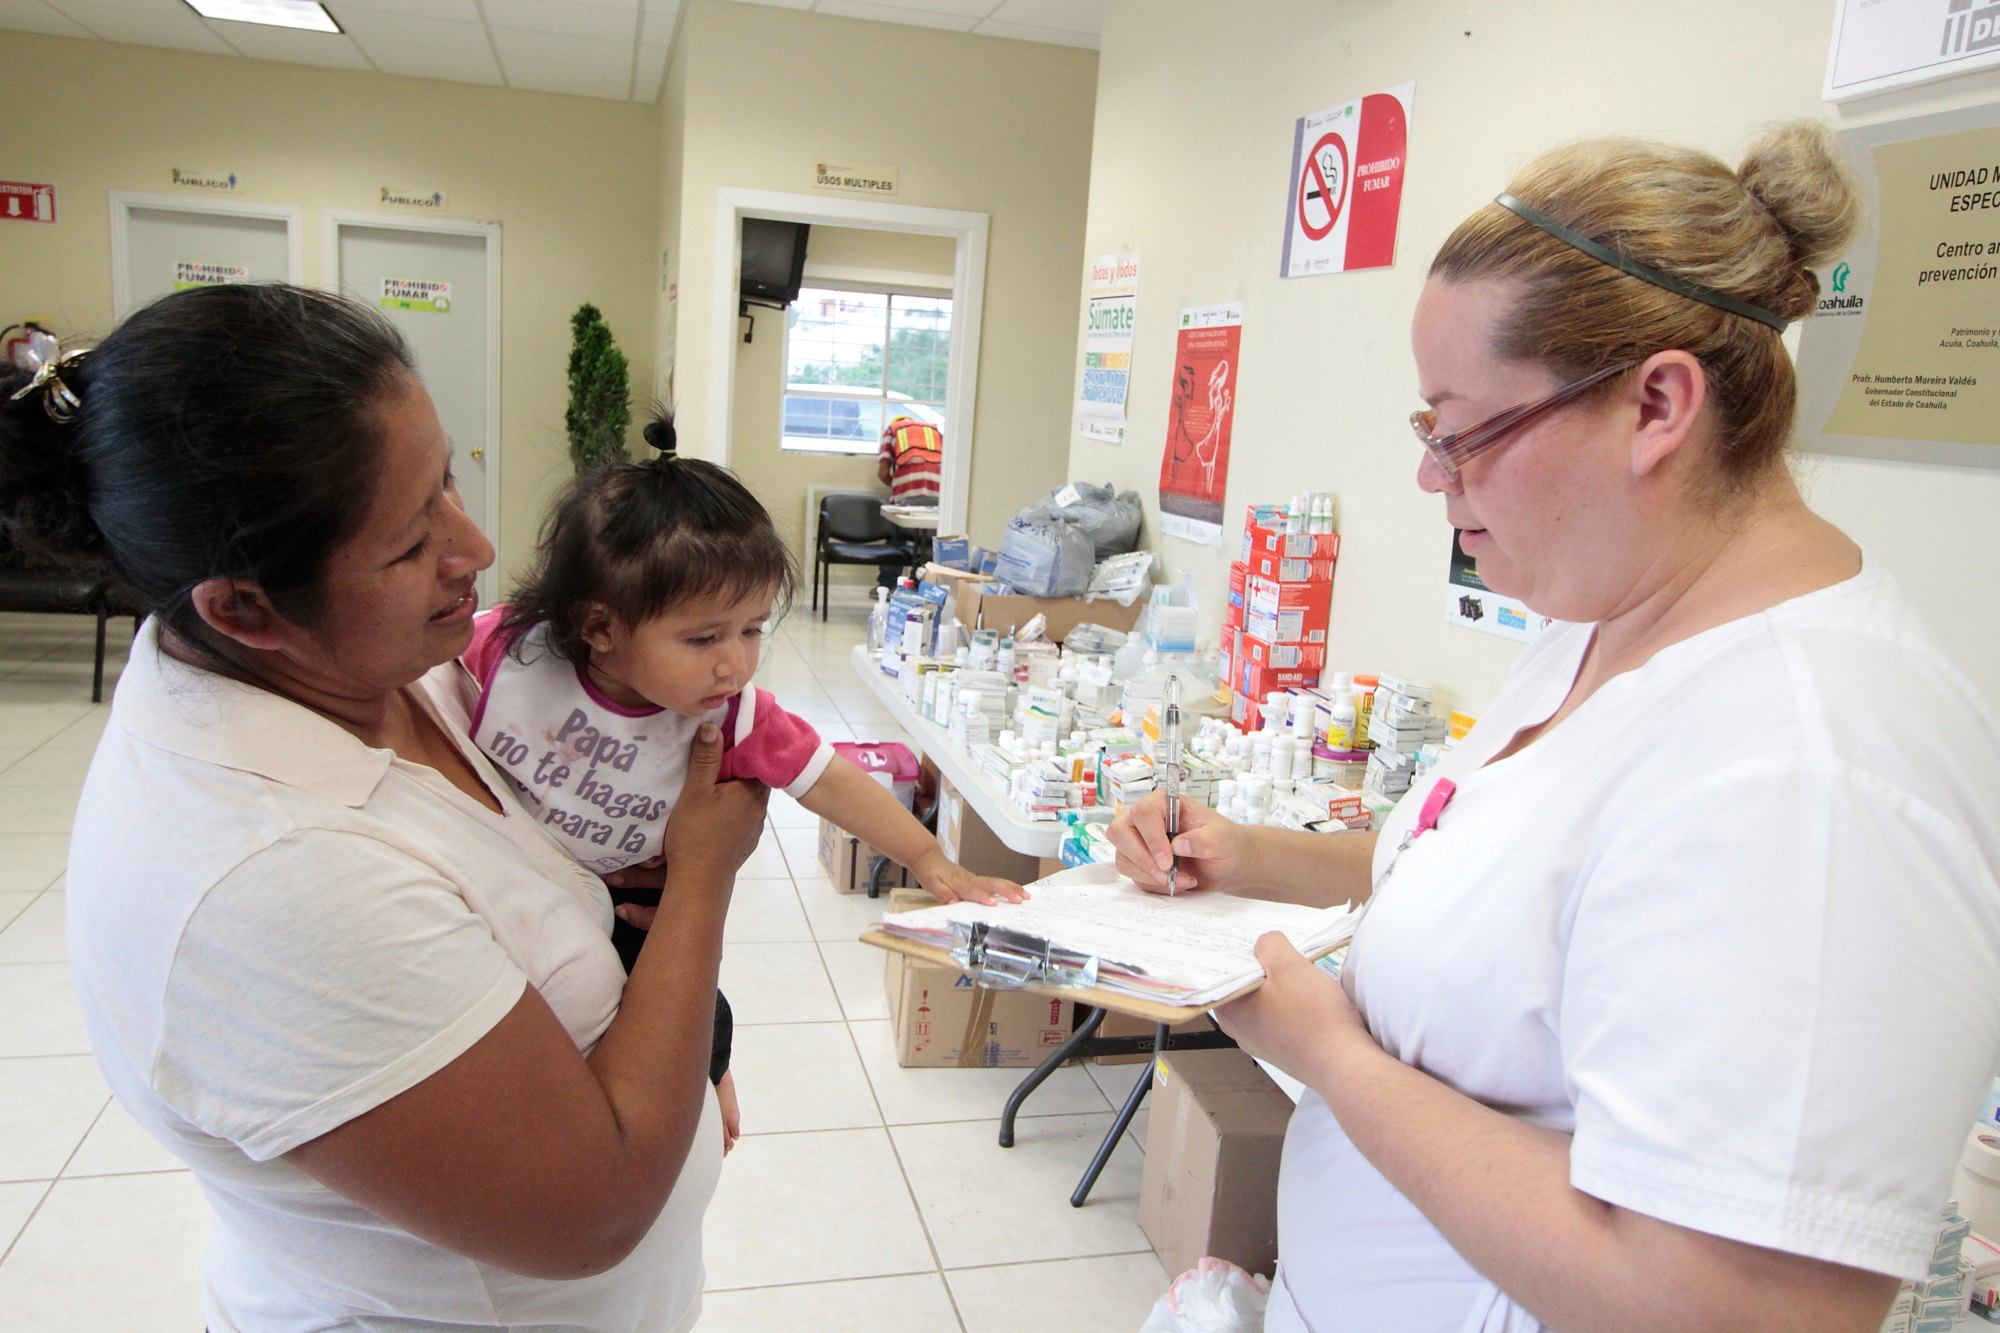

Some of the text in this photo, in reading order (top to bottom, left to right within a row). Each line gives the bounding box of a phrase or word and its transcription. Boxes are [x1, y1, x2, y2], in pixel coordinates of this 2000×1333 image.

[1357, 157, 1400, 177] PROHIBIDO
[818, 176, 892, 190] USOS MULTIPLES
[1363, 176, 1390, 192] FUMAR
[1929, 168, 1988, 191] UNIDAD
[1936, 241, 1984, 258] Centro
[178, 263, 244, 276] PROHIBIDO
[1918, 262, 1997, 287] prevención
[178, 272, 225, 283] FUMAR
[385, 279, 447, 291] PROHIBIDO
[385, 288, 428, 299] FUMAR
[1816, 294, 1863, 310] oahuila
[1088, 302, 1133, 330] Súmate
[1950, 328, 1990, 337] Patrimonio
[1939, 339, 2000, 349] Acuña, Coahuila,
[1852, 374, 1977, 386] Profr. Humberto Moreira Valdés
[1865, 387, 1957, 398] Gobernador Constitucional
[1869, 399, 1947, 409] del Estado de Coahuila
[556, 708, 647, 773] Papá
[490, 731, 529, 766] no
[533, 751, 570, 788] te
[575, 769, 667, 821] hagas
[544, 808, 647, 854] para la
